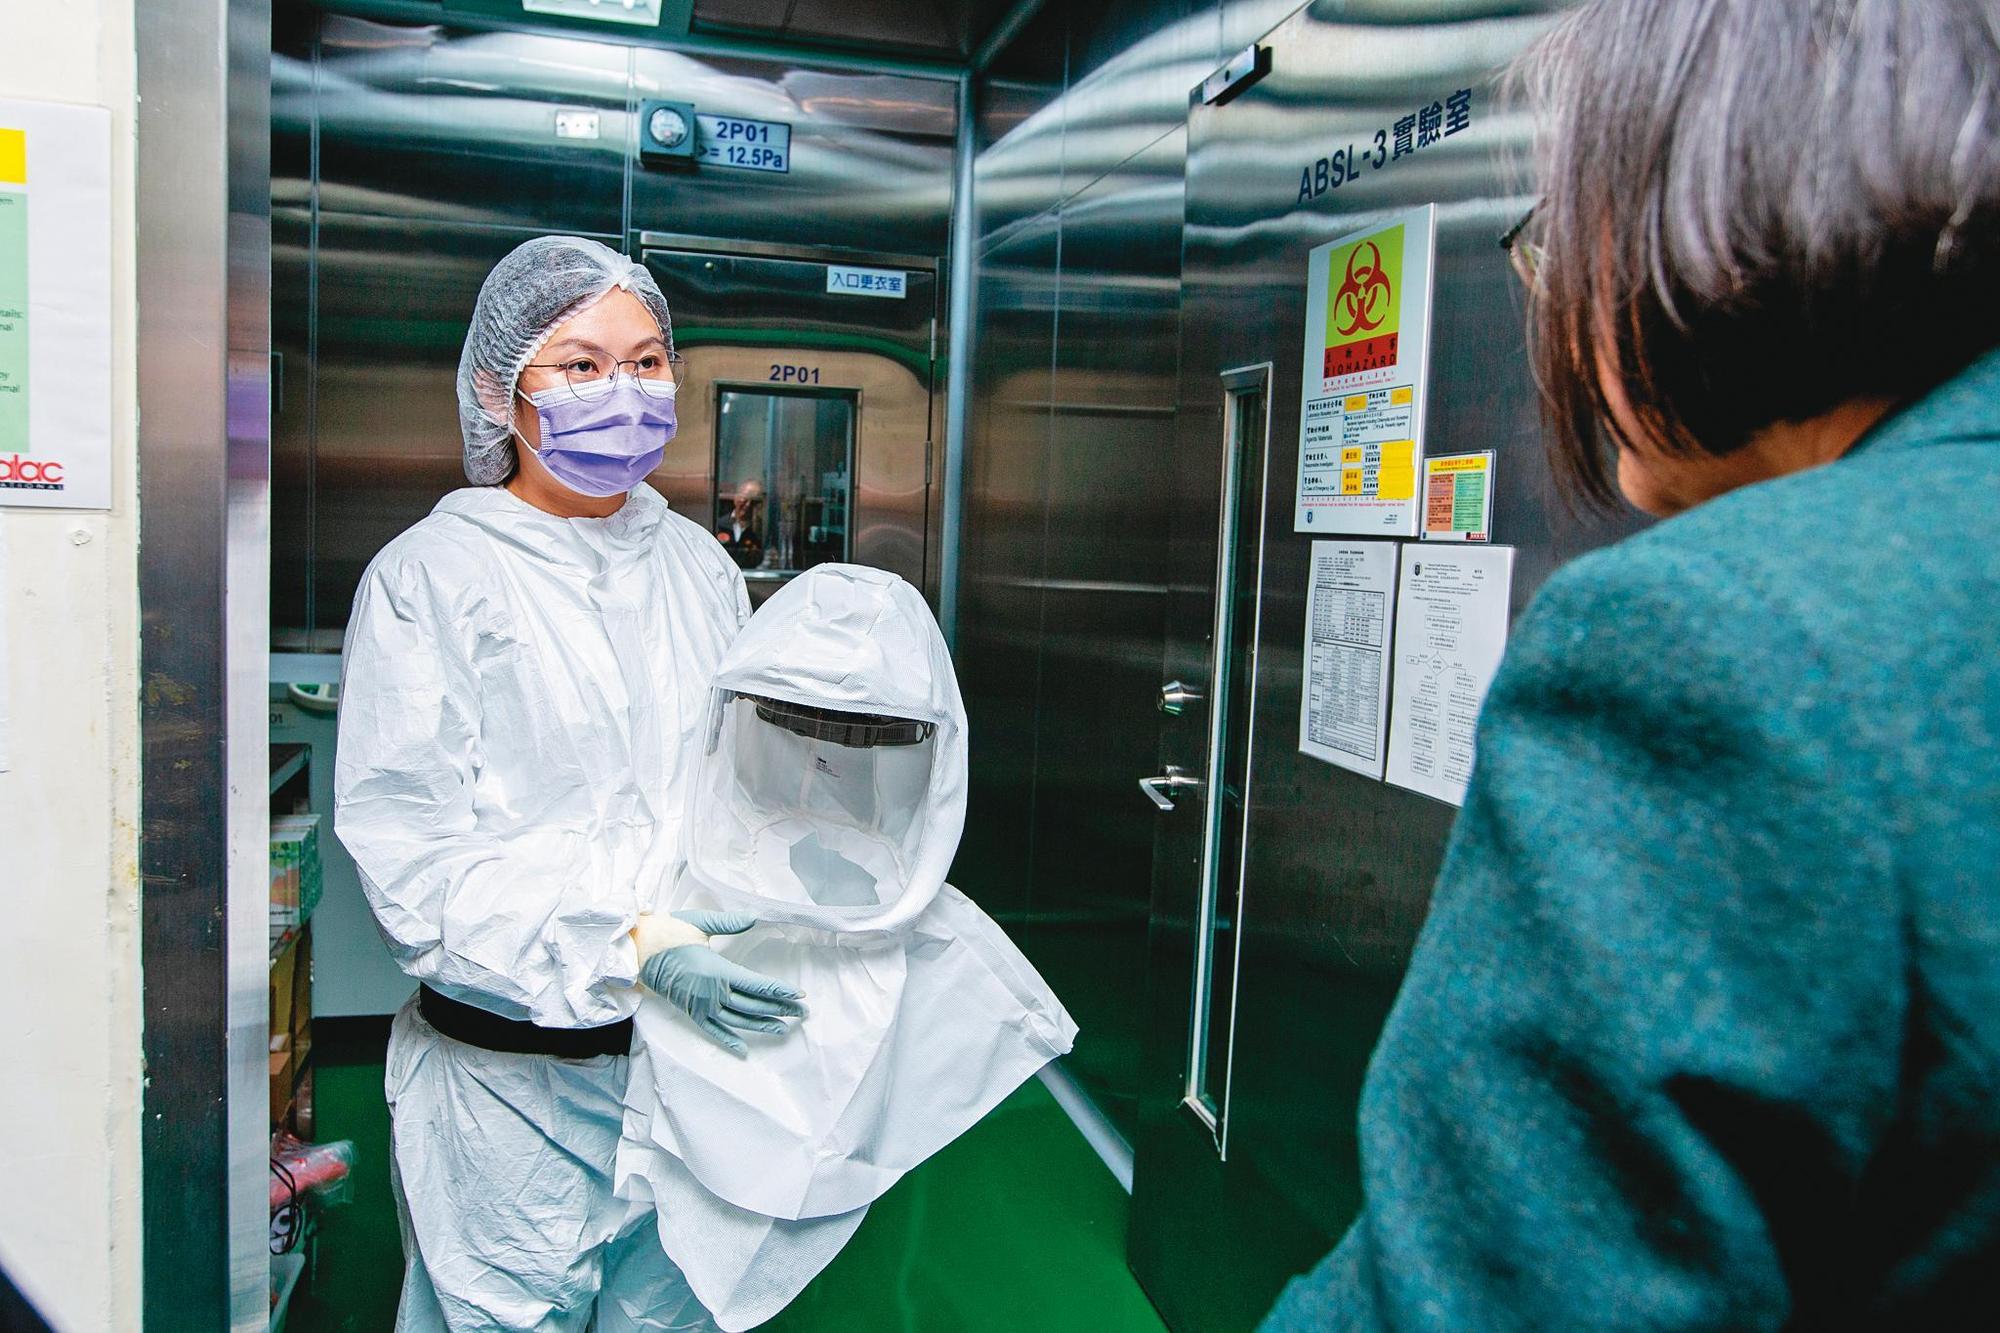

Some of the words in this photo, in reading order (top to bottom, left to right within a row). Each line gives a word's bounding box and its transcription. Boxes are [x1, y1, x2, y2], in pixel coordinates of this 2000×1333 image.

[716, 121, 769, 143] 2P01
[727, 146, 783, 168] 12.5Pa
[832, 272, 902, 292] 入口更衣室
[769, 364, 819, 384] 2P01
[1325, 353, 1397, 378] BIOHAZARD
